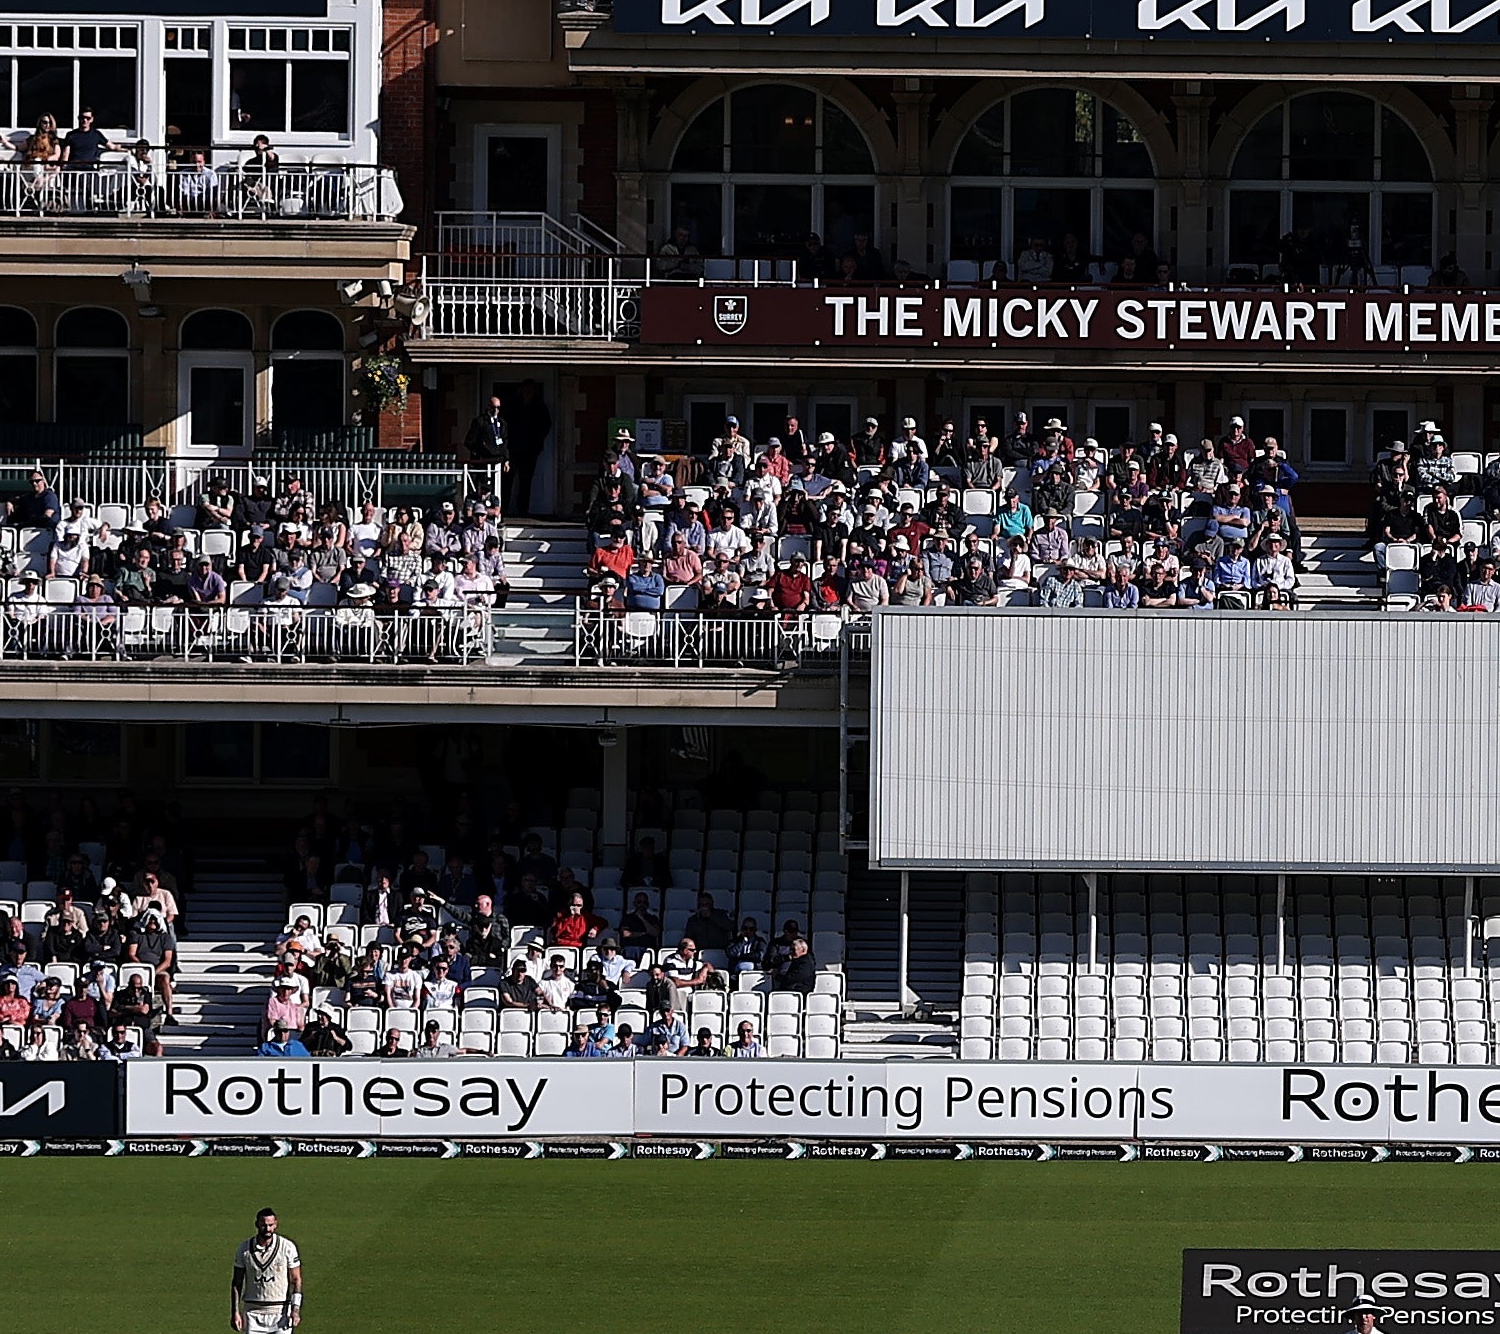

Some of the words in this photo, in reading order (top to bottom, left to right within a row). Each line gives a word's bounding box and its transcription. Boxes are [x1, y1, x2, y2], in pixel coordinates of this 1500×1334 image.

[824, 296, 923, 337] THE
[943, 297, 1099, 338] MICKY
[1116, 299, 1346, 341] STEWART
[165, 1063, 549, 1130] Rothesay
[660, 1073, 923, 1130] Protecting
[946, 1076, 1175, 1122] Pensions
[129, 1141, 186, 1153] Rothesay
[297, 1142, 354, 1155] Rothesay
[465, 1144, 522, 1155] Rothesay
[636, 1145, 694, 1157] Rothesay
[812, 1146, 868, 1157] Rothesay
[978, 1146, 1034, 1157] Rothesay
[1145, 1147, 1201, 1159] Rothesay
[1312, 1148, 1368, 1159] Rothesay
[1236, 1305, 1354, 1324] Protectin
[1377, 1305, 1495, 1325] Pensions
